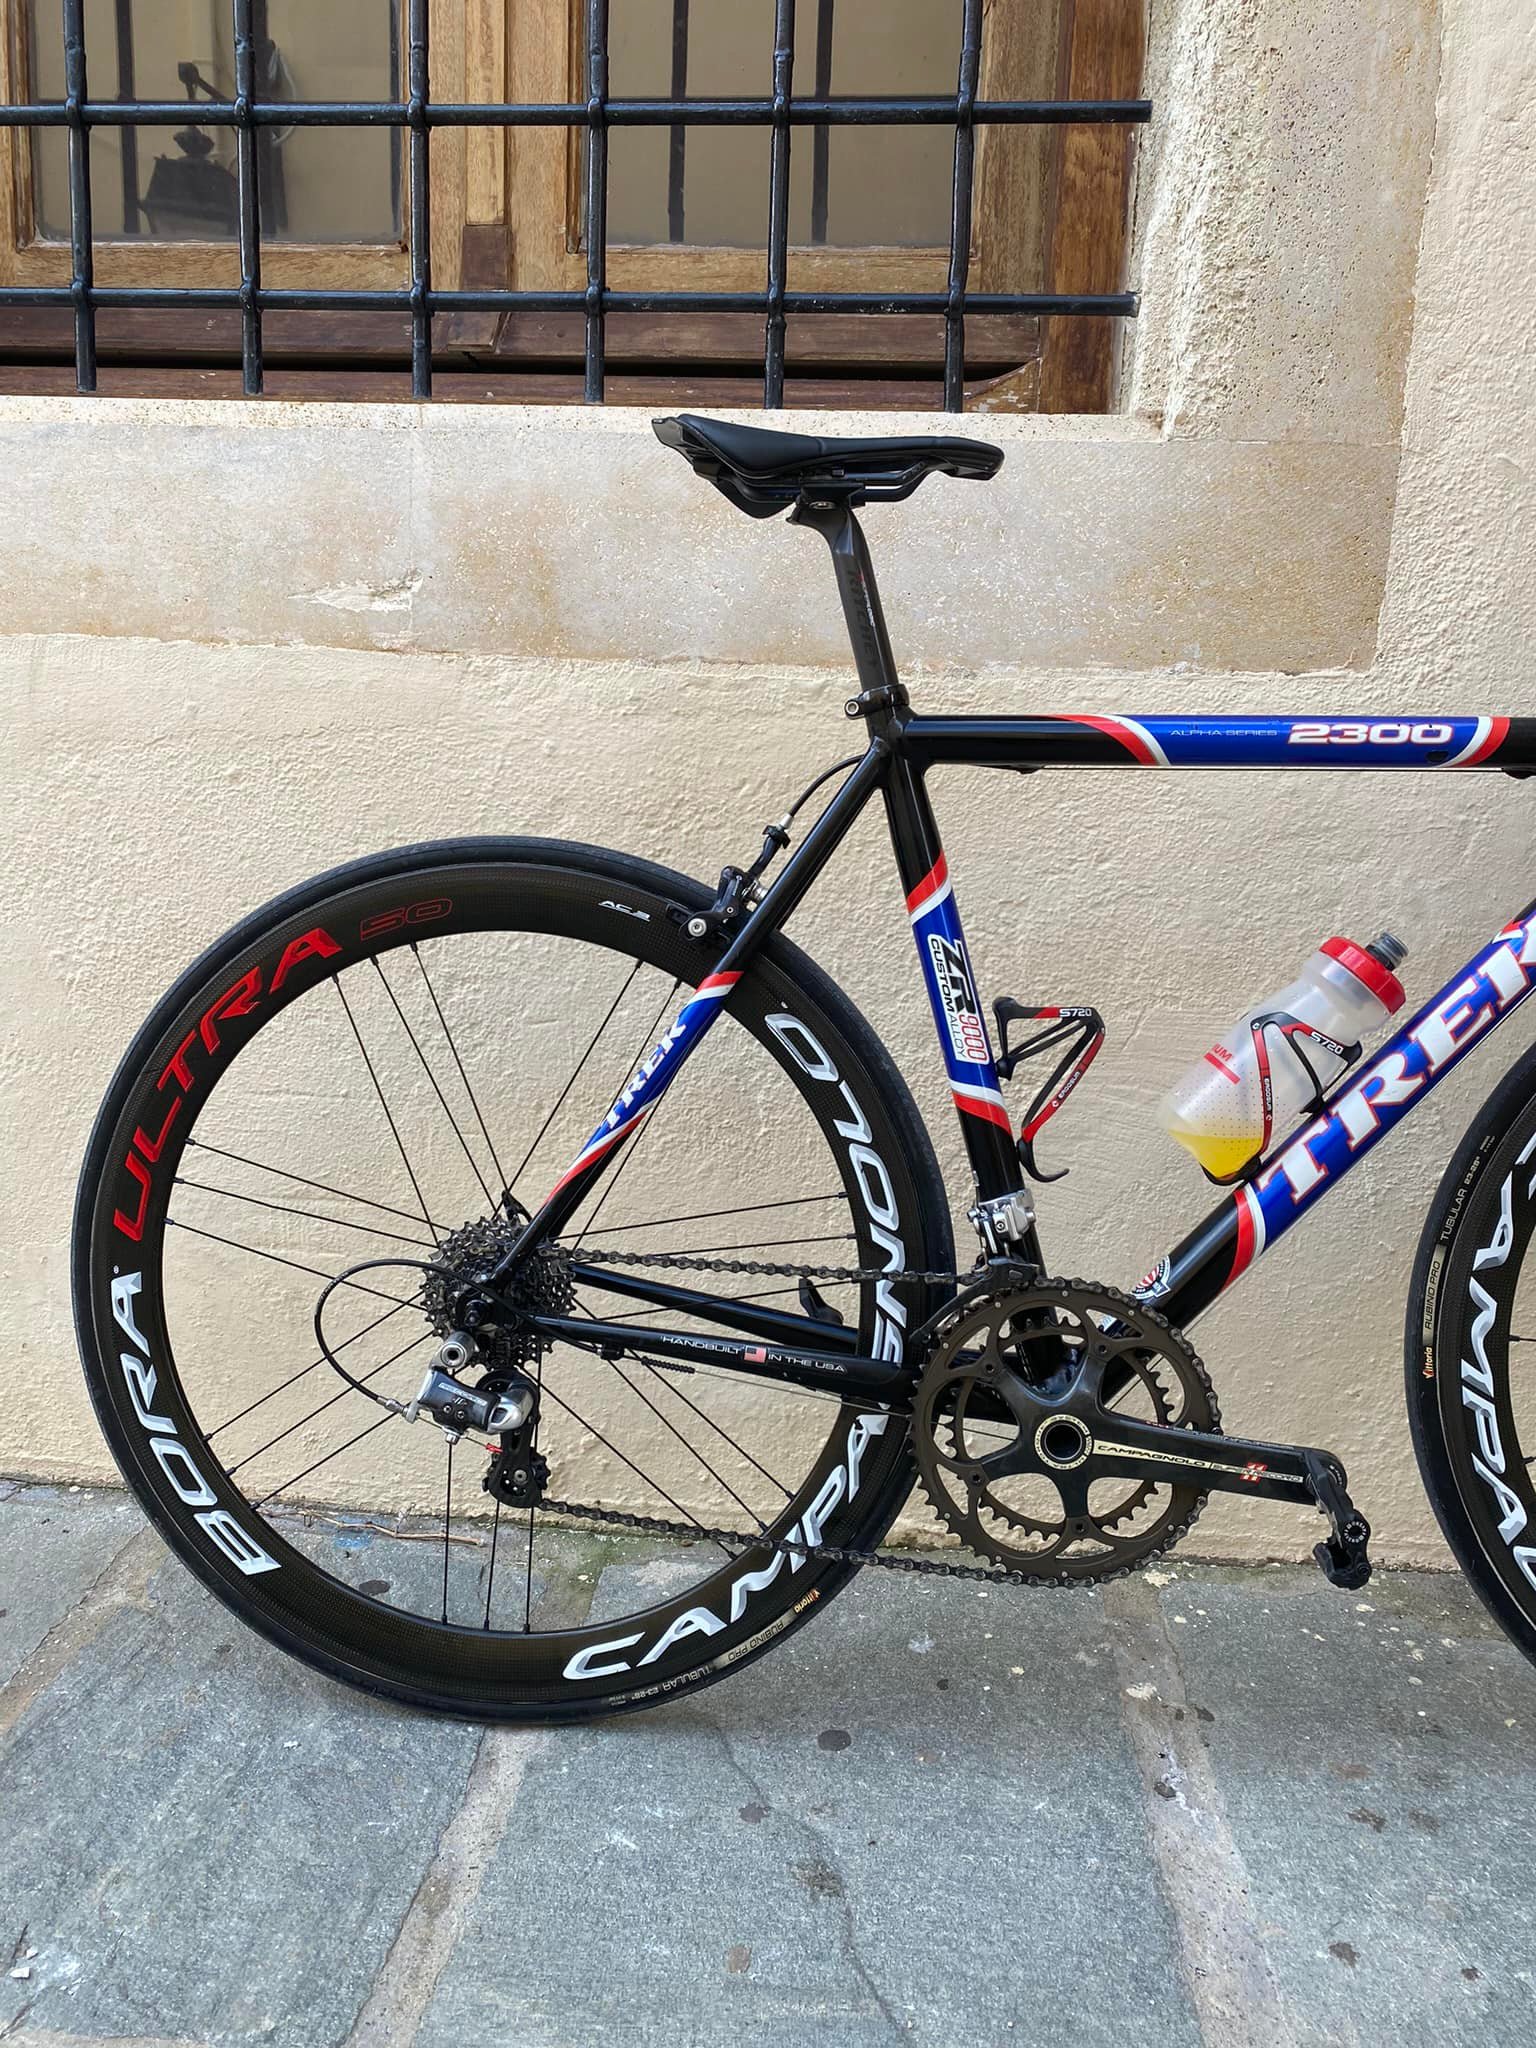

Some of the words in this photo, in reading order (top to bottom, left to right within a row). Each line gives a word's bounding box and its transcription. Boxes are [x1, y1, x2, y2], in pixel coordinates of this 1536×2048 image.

[1170, 729, 1221, 737] ALPHA
[1225, 729, 1278, 737] SERIES
[1287, 723, 1453, 745] 2300
[361, 898, 453, 940] 50
[931, 938, 955, 1012] CUSTOM
[948, 1014, 967, 1058] ALLOY
[1060, 1008, 1092, 1017] S720
[1310, 1031, 1344, 1055] S720
[113, 927, 343, 1241] ULTRA
[604, 1022, 687, 1129] TREK
[1440, 1188, 1467, 1241] TUBULAR
[1431, 1261, 1440, 1284] PRO
[1425, 1287, 1437, 1330] RUBINO
[768, 1353, 782, 1362] IN
[786, 1356, 812, 1367] THE
[815, 1362, 846, 1372] USA
[1423, 1347, 1433, 1379] Vittoria
[112, 1271, 281, 1575] BORA
[1098, 1445, 1205, 1467] CAMPAGNOLO
[794, 1588, 821, 1613] Vittoria
[750, 1620, 784, 1649] RUBINO
[728, 1647, 748, 1661] PRO
[662, 1665, 712, 1691] TUBULAR
